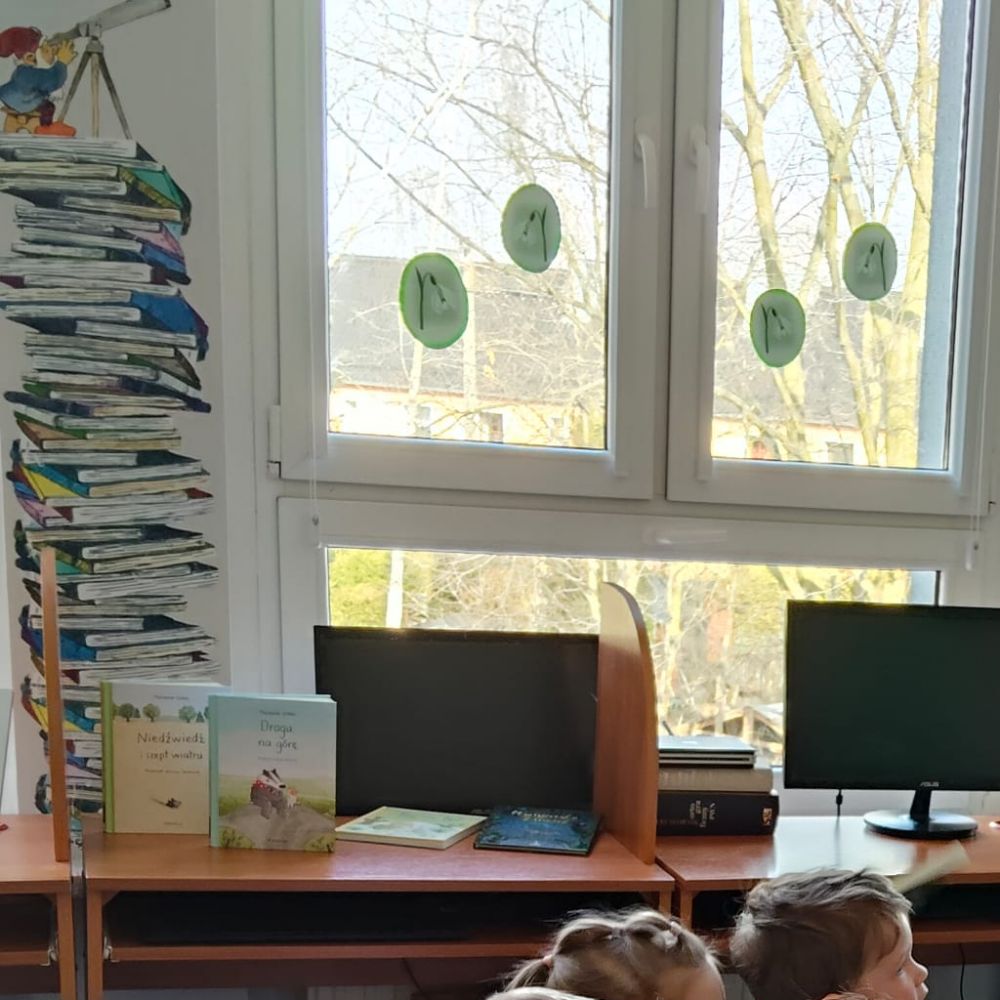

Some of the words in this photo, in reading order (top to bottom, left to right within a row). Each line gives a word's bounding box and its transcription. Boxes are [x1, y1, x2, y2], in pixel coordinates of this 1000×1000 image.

[260, 719, 293, 739] Droga
[136, 731, 206, 744] Niedźwiedź
[275, 739, 298, 753] górę
[171, 750, 204, 760] wiatru
